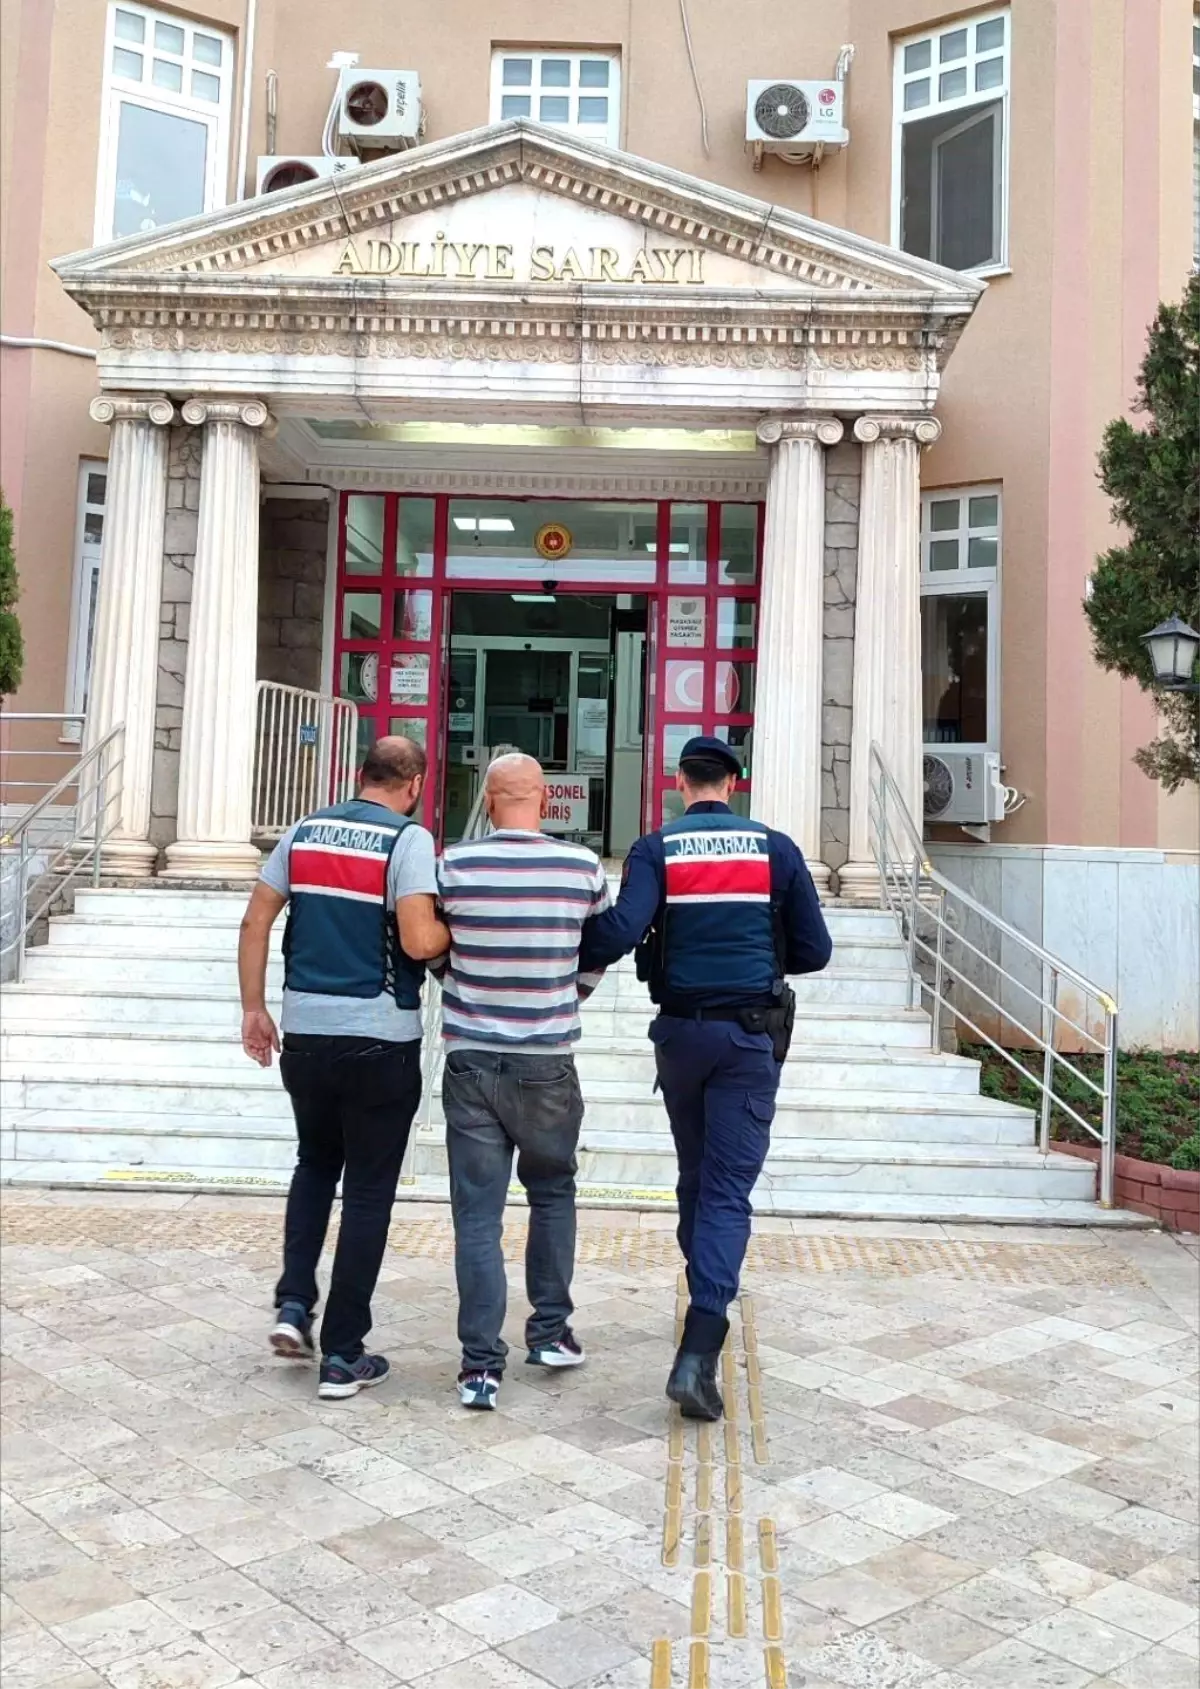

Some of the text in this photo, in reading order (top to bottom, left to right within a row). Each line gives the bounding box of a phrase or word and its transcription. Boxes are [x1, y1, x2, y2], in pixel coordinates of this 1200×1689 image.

[396, 80, 408, 117] arçelik
[820, 108, 833, 117] LG
[332, 231, 704, 284] ADLİYE SARAYI
[544, 784, 586, 800] SONEL
[304, 825, 384, 852] JANDARMA
[675, 836, 760, 856] JANDARMA
